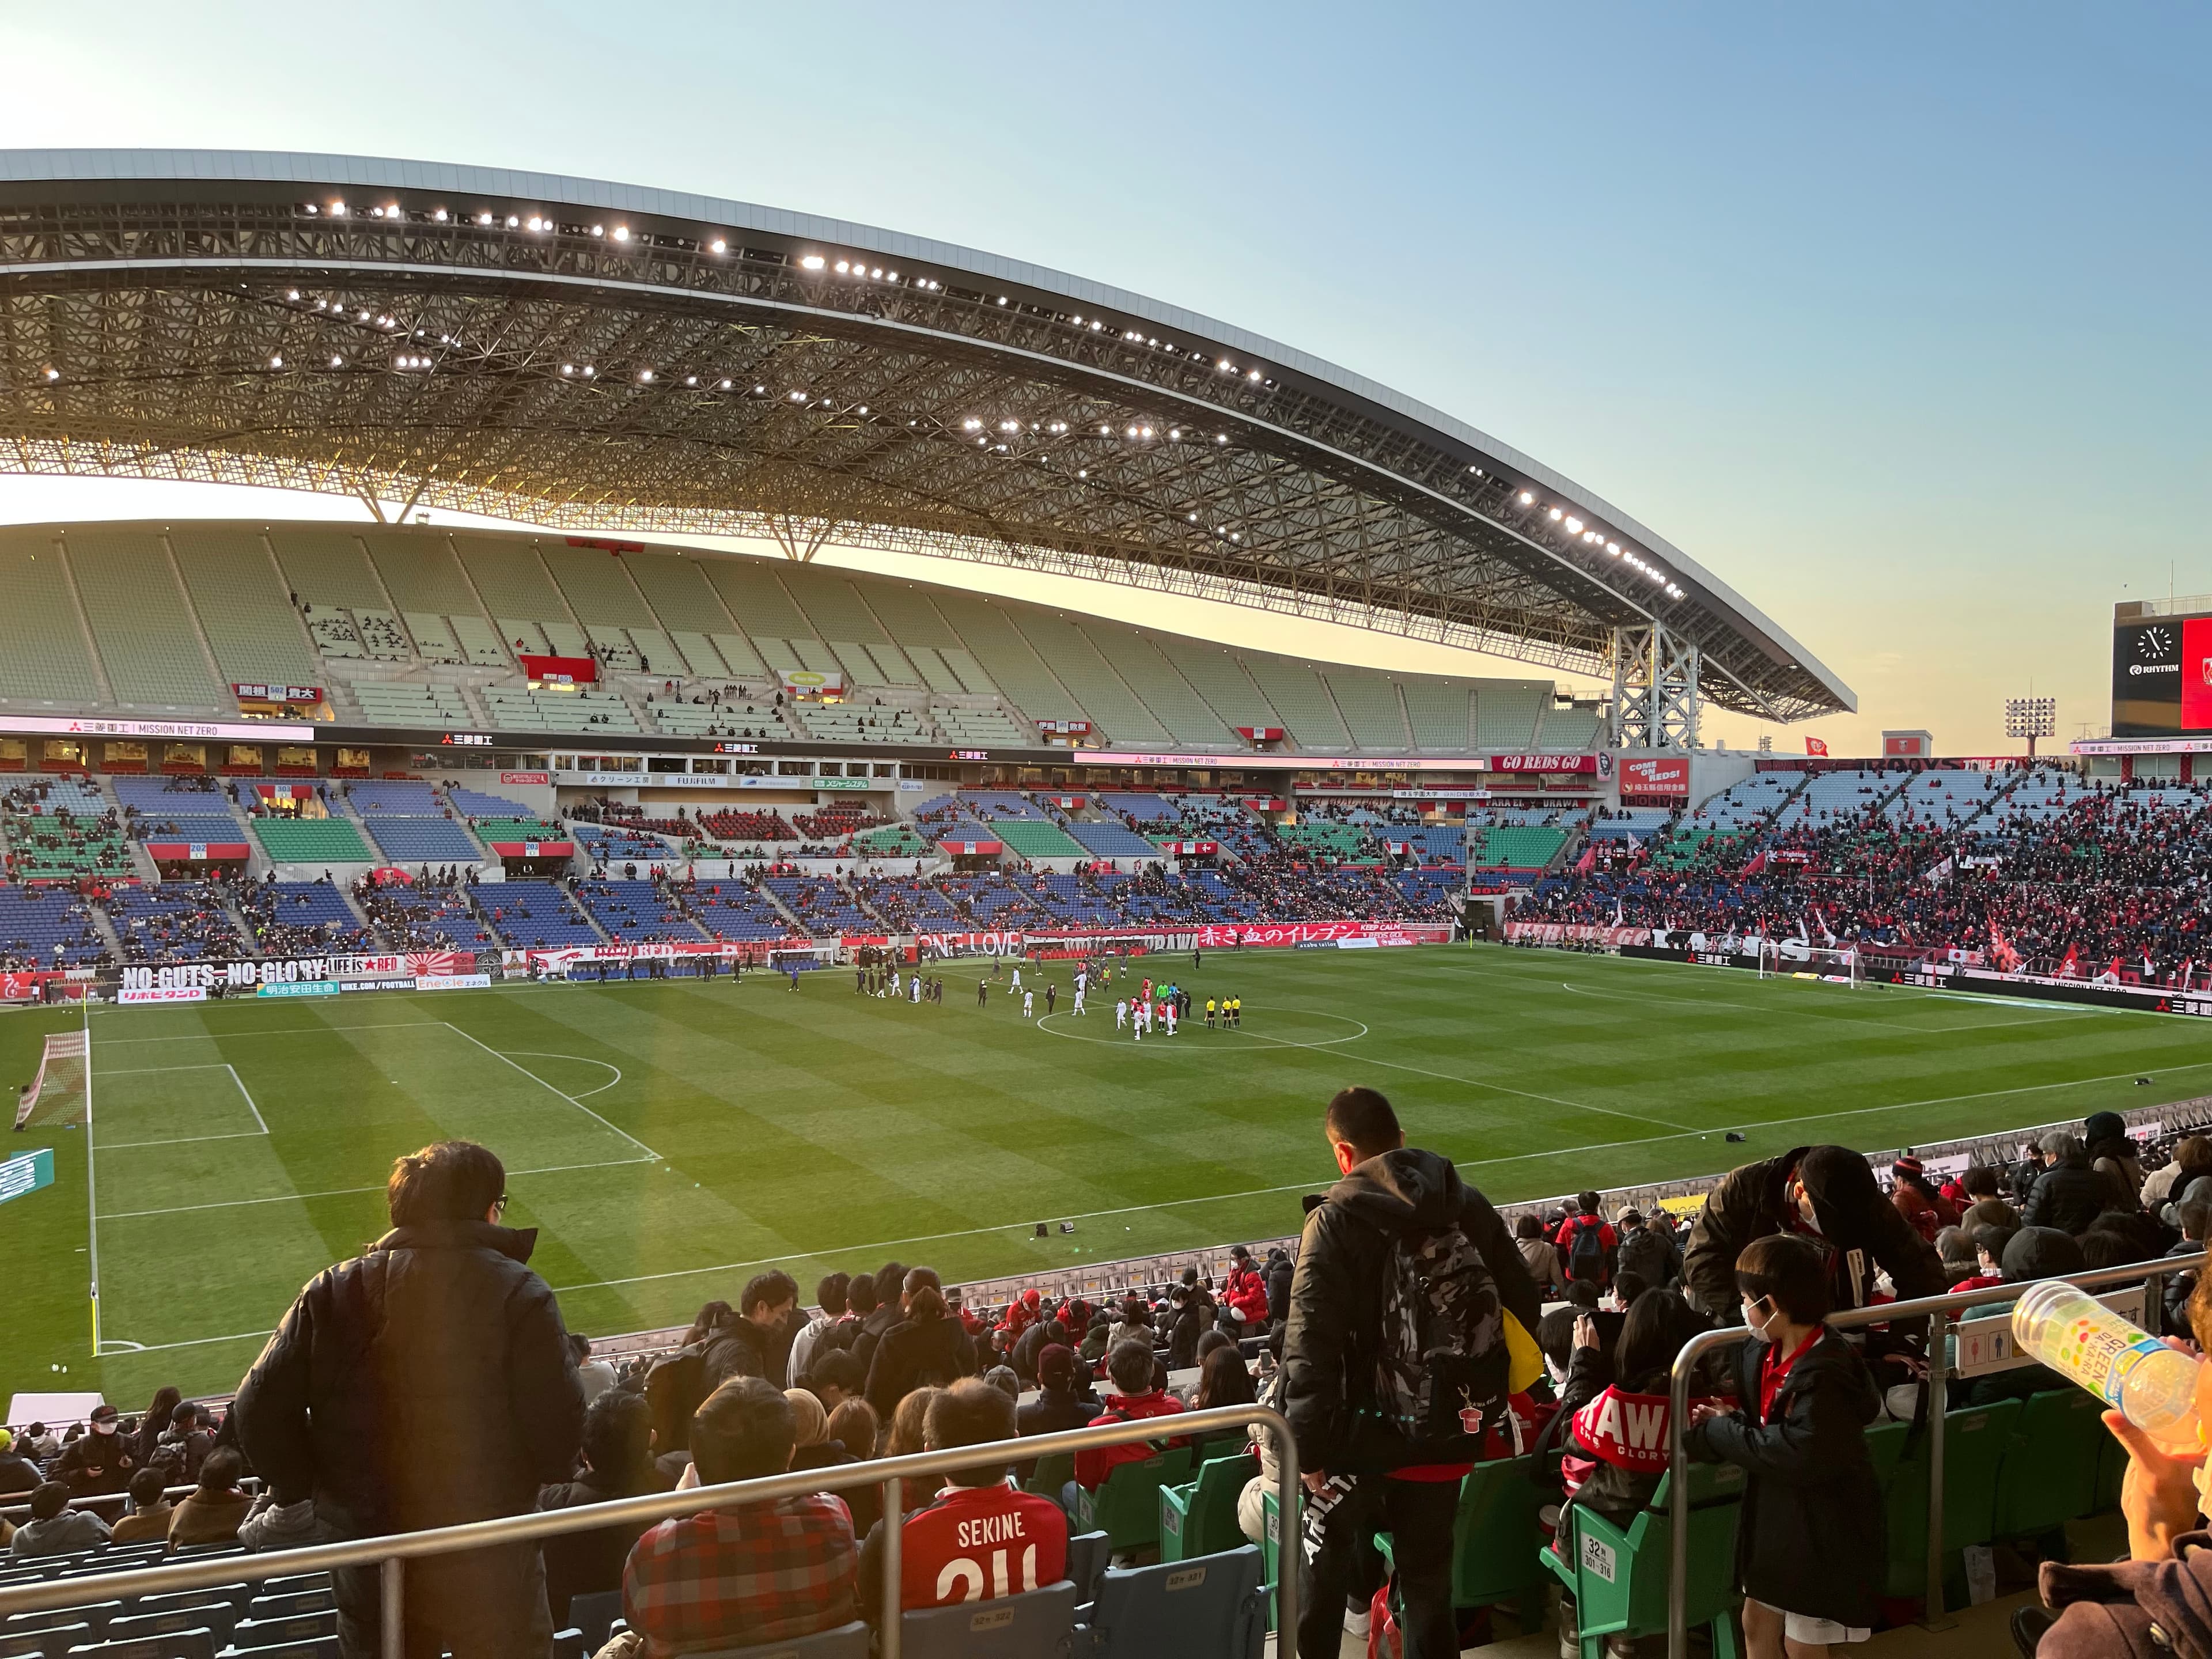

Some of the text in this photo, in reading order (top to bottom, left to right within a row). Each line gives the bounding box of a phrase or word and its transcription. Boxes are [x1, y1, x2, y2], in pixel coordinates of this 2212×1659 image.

[2143, 664, 2179, 673] RHYTHM
[84, 722, 218, 736] 三菱重工 MISSION NET ZERO
[1502, 756, 1581, 768] GO REDS GO
[1629, 761, 1657, 771] COME
[1649, 770, 1680, 782] REDS!
[1486, 799, 1509, 807] PARA
[1543, 800, 1579, 808] URAWA
[1202, 844, 1211, 852] 和
[1200, 924, 1355, 946] 赤き血のイレブン
[1618, 929, 1650, 946] GO
[642, 945, 674, 956] RED
[917, 934, 963, 958] ONE
[969, 933, 1019, 956] LOVE
[328, 958, 349, 974] LIFE
[377, 956, 397, 972] RED
[123, 967, 153, 990] NO
[228, 963, 256, 985] NO
[261, 959, 325, 984] GLORY
[124, 990, 200, 1001] リポビタンD
[266, 982, 335, 995] 明治安田生命
[2092, 1338, 2126, 1384] GREEN
[1618, 1446, 1670, 1461] GLORY
[958, 1512, 1025, 1548] SEKINE
[1589, 1538, 1600, 1558] 32
